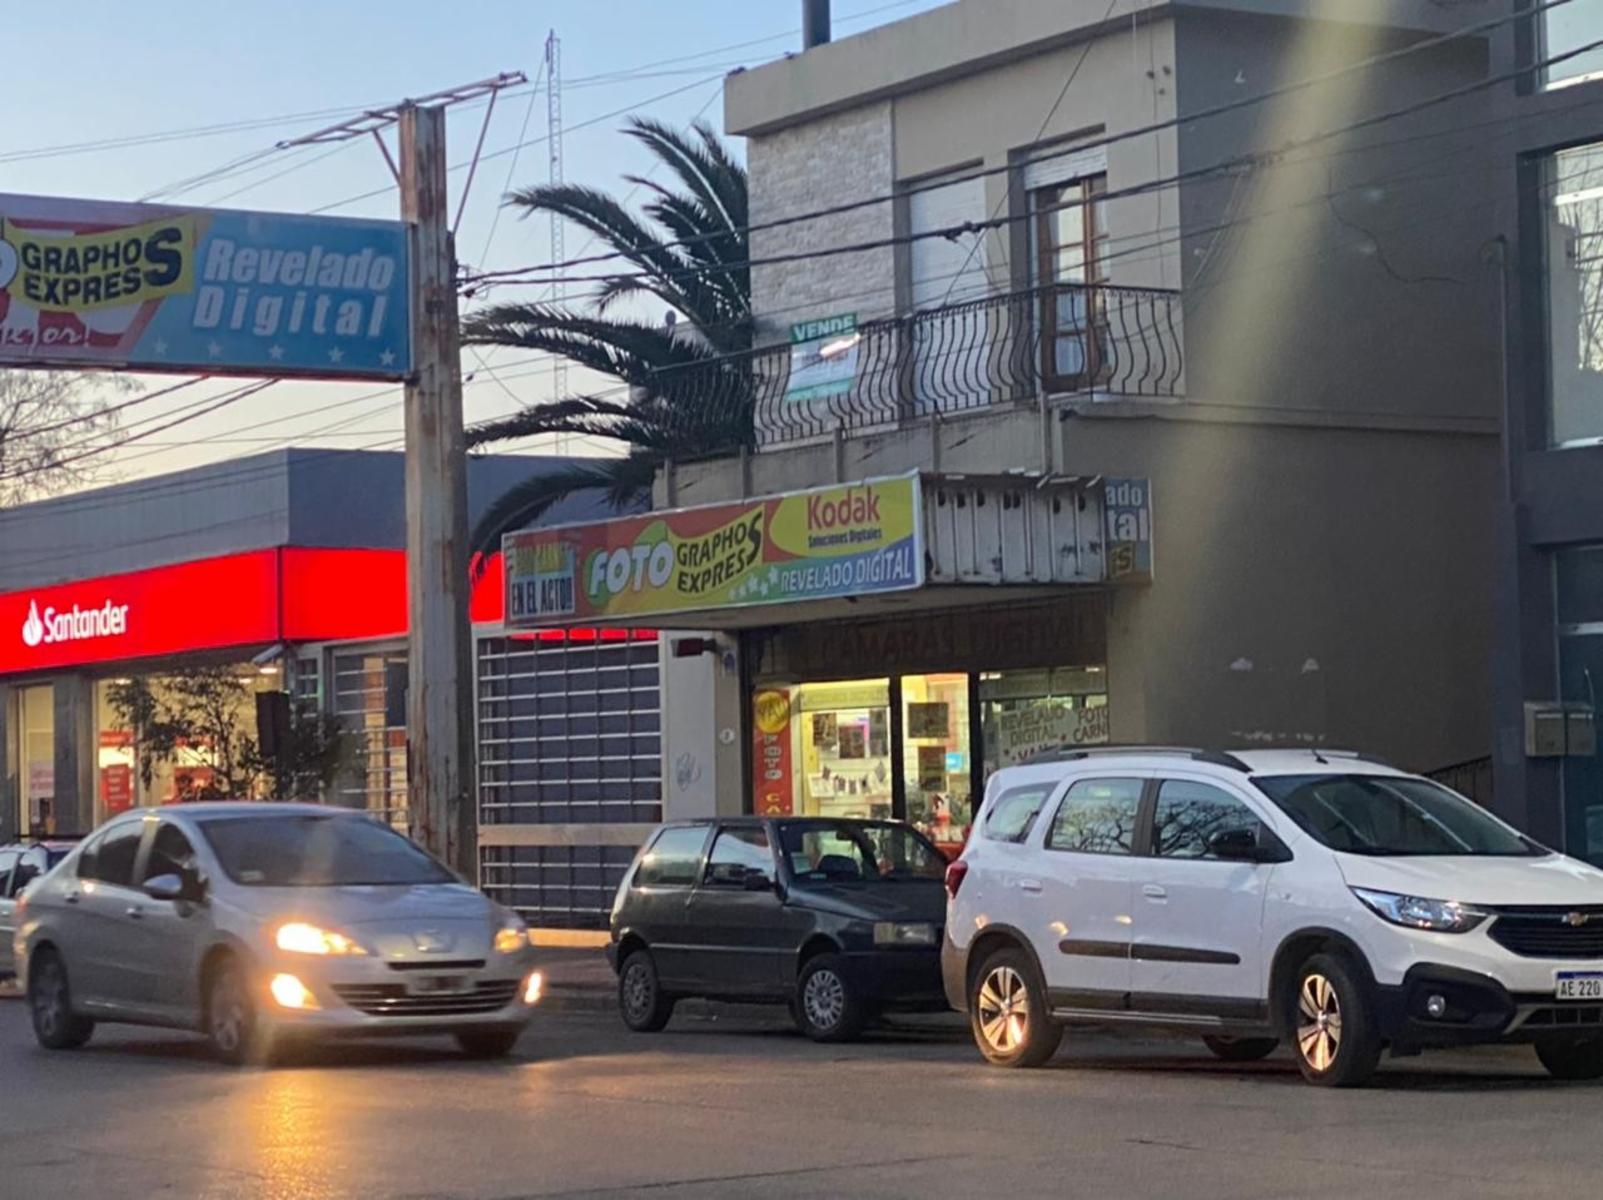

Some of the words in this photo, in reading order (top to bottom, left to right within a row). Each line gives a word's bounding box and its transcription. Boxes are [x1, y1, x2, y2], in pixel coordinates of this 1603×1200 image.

[204, 237, 395, 292] Revelado
[193, 285, 389, 339] Digital
[793, 314, 855, 341] VENDE
[807, 486, 881, 530] Kodak
[589, 540, 674, 596] FOTO
[781, 561, 852, 593] REVELADO
[856, 547, 912, 583] DIGITAL
[44, 599, 129, 643] Santander
[1010, 724, 1057, 746] DIGITAL
[1560, 981, 1575, 996] AE
[1578, 980, 1600, 996] 220
